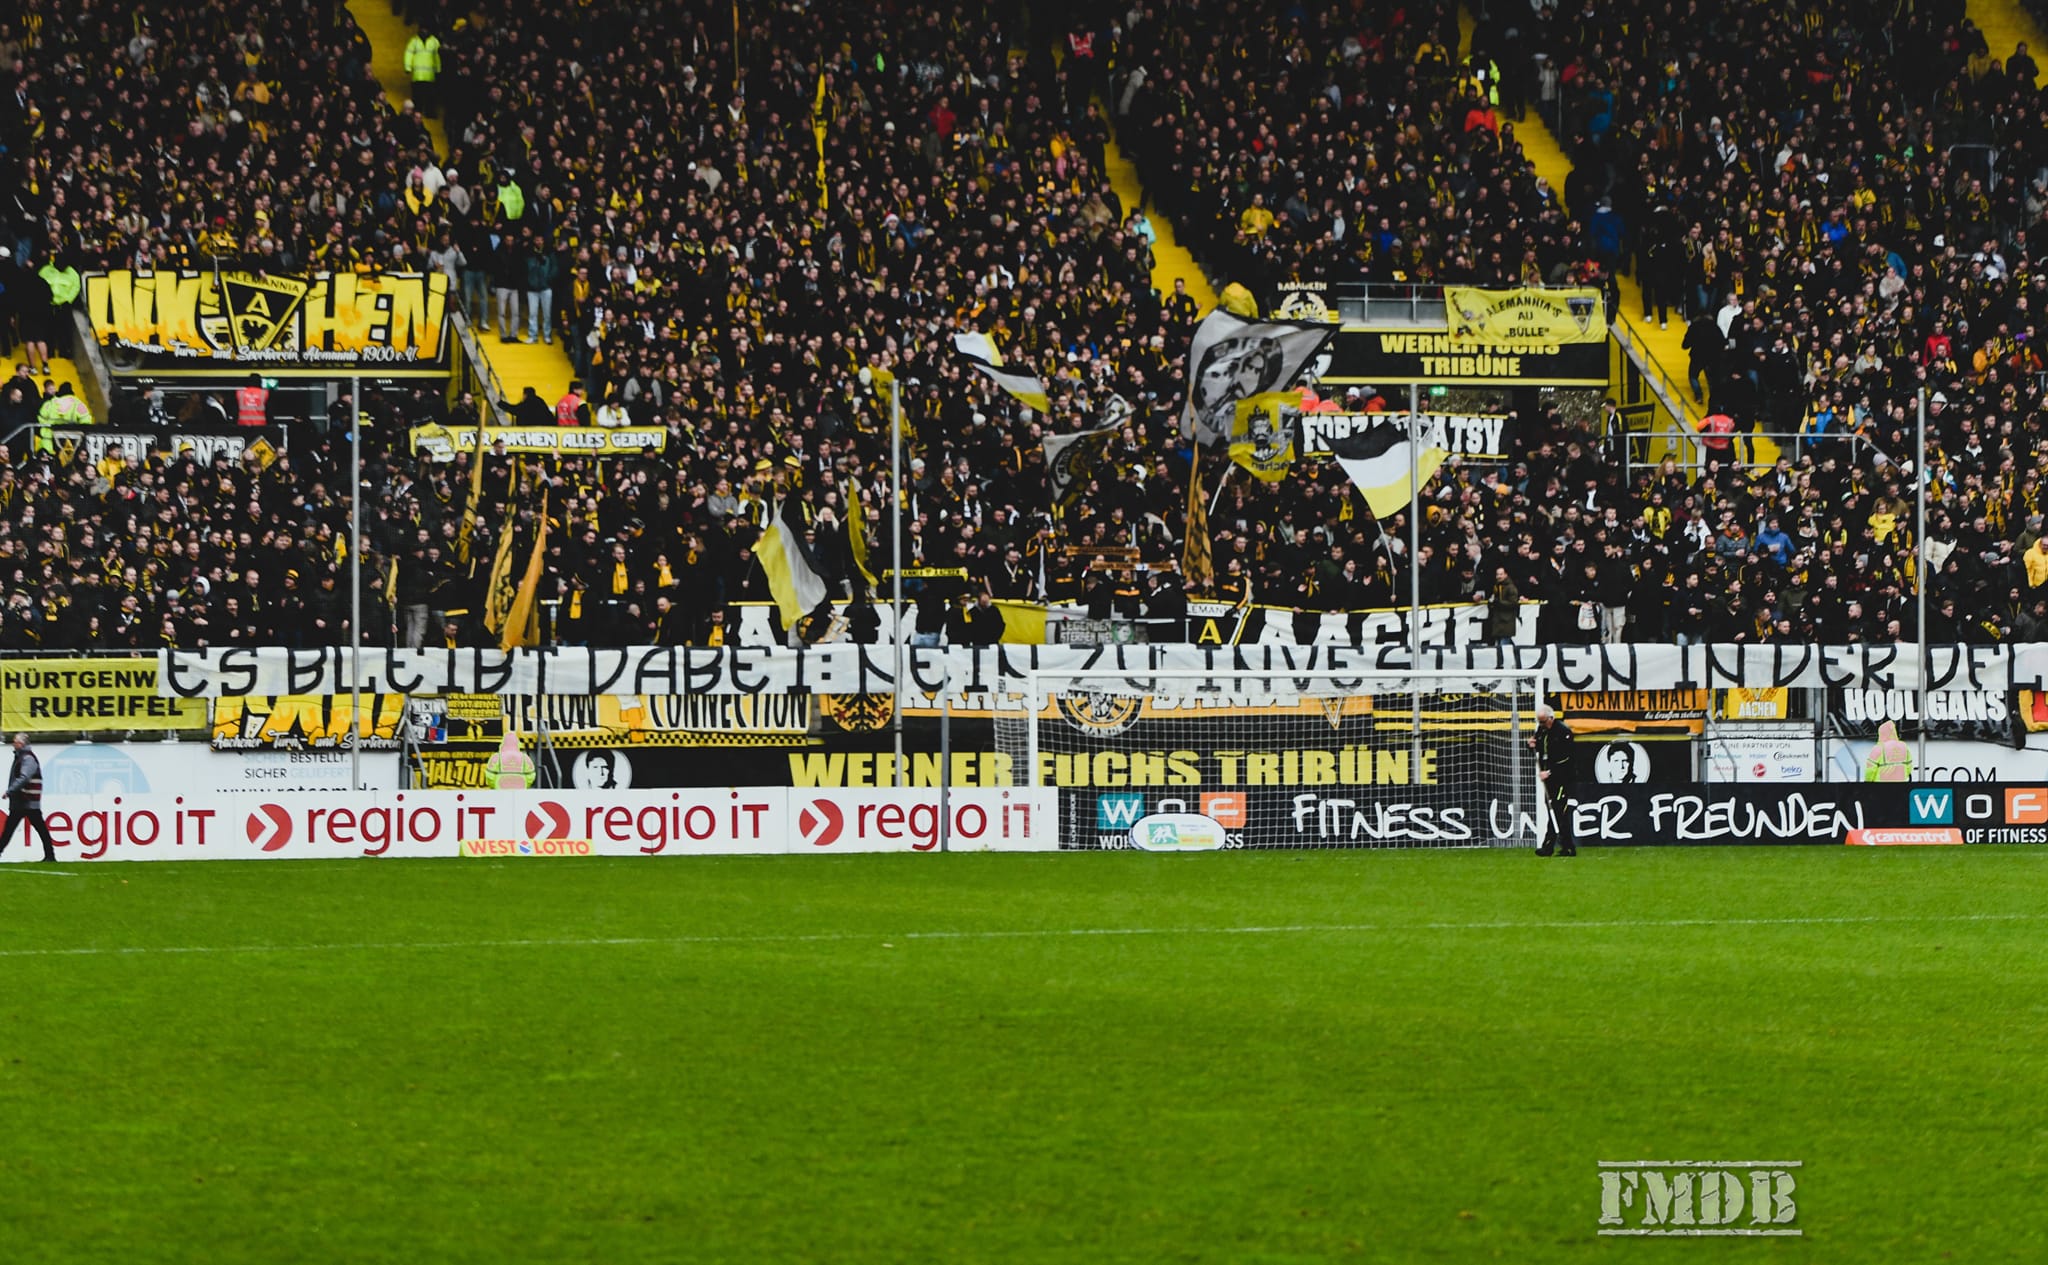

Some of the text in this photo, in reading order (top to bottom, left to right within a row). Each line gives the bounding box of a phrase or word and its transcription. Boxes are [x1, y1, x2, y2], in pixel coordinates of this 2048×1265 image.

[246, 291, 271, 318] A
[1517, 311, 1534, 321] AU
[362, 345, 395, 361] 1900
[1420, 355, 1521, 376] TRIBÜNE
[561, 432, 605, 447] ALLES
[611, 432, 663, 448] GEBEN!
[1198, 618, 1223, 645] A
[5, 667, 159, 690] HÜRTGENW
[167, 642, 2043, 698] ES BLEIBT DABEI: NEIN ZU INVESTOREN IN DER DFL
[29, 696, 184, 719] RUREIFEL
[1565, 688, 1698, 711] ZUSAMMENHALT
[1738, 701, 1777, 717] AACHEN
[504, 693, 808, 732] YELLOW CONNECTION
[314, 733, 337, 748] und
[339, 732, 402, 750] Sortverein
[290, 752, 348, 763] BESTELLT.
[788, 743, 1439, 788] WERNER FUCHS TRIBÜNE
[244, 768, 288, 779] SICHER
[308, 794, 442, 857] regio
[585, 792, 717, 854] regio
[857, 790, 988, 852] rego
[1292, 792, 1865, 840] FITNESS UNER FREUNDEN
[466, 839, 590, 856] WEST LOTTO
[1874, 829, 1953, 844] camcontrol
[1965, 828, 2048, 845] OF FITNESS
